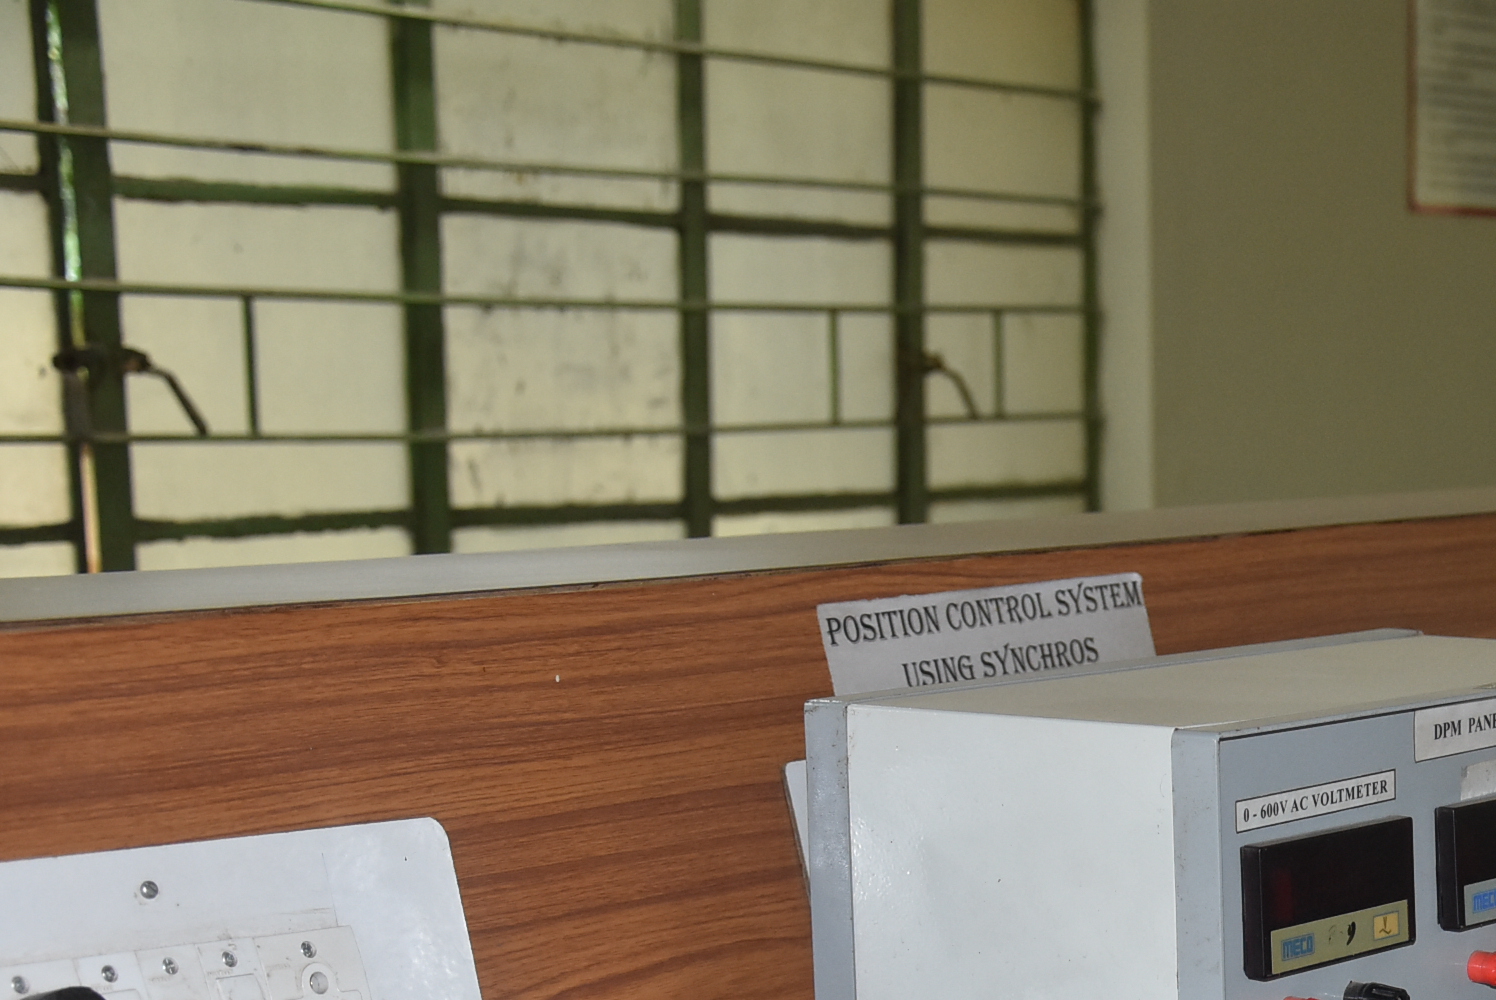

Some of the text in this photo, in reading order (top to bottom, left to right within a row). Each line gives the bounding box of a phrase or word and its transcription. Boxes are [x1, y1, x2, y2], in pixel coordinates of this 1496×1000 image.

[826, 580, 1143, 647] POSITION CONTROL SYSTEM
[902, 637, 1099, 688] USING SYNCHROS
[1434, 720, 1462, 740] DPM
[1243, 807, 1250, 823] 0
[1260, 800, 1288, 819] 600V
[1291, 796, 1309, 813] AC
[1311, 779, 1388, 808] VOLTMETER
[1282, 934, 1315, 960] MECO
